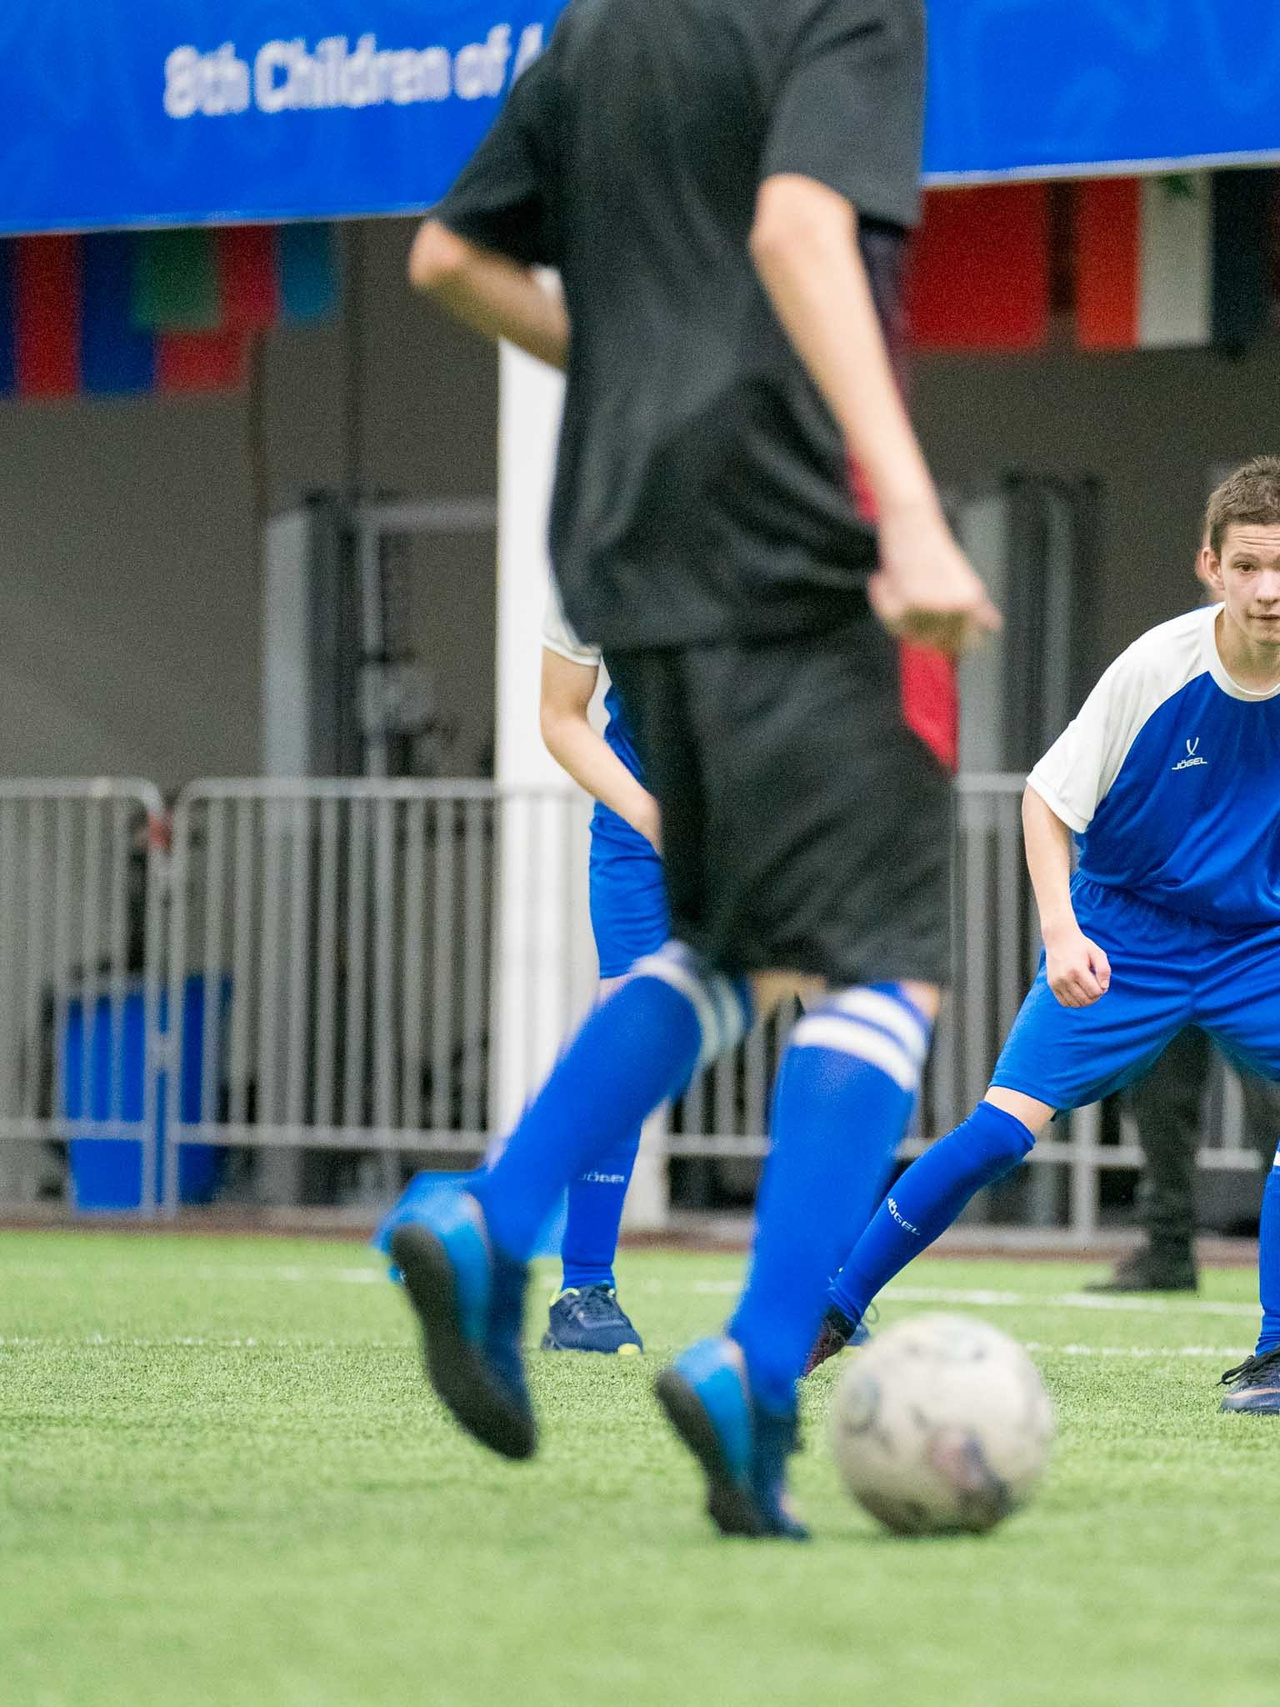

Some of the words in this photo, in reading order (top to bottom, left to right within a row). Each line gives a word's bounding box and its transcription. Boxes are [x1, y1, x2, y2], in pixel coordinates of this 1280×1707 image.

[163, 42, 250, 118] 8th
[254, 33, 451, 114] Children
[455, 23, 511, 99] of
